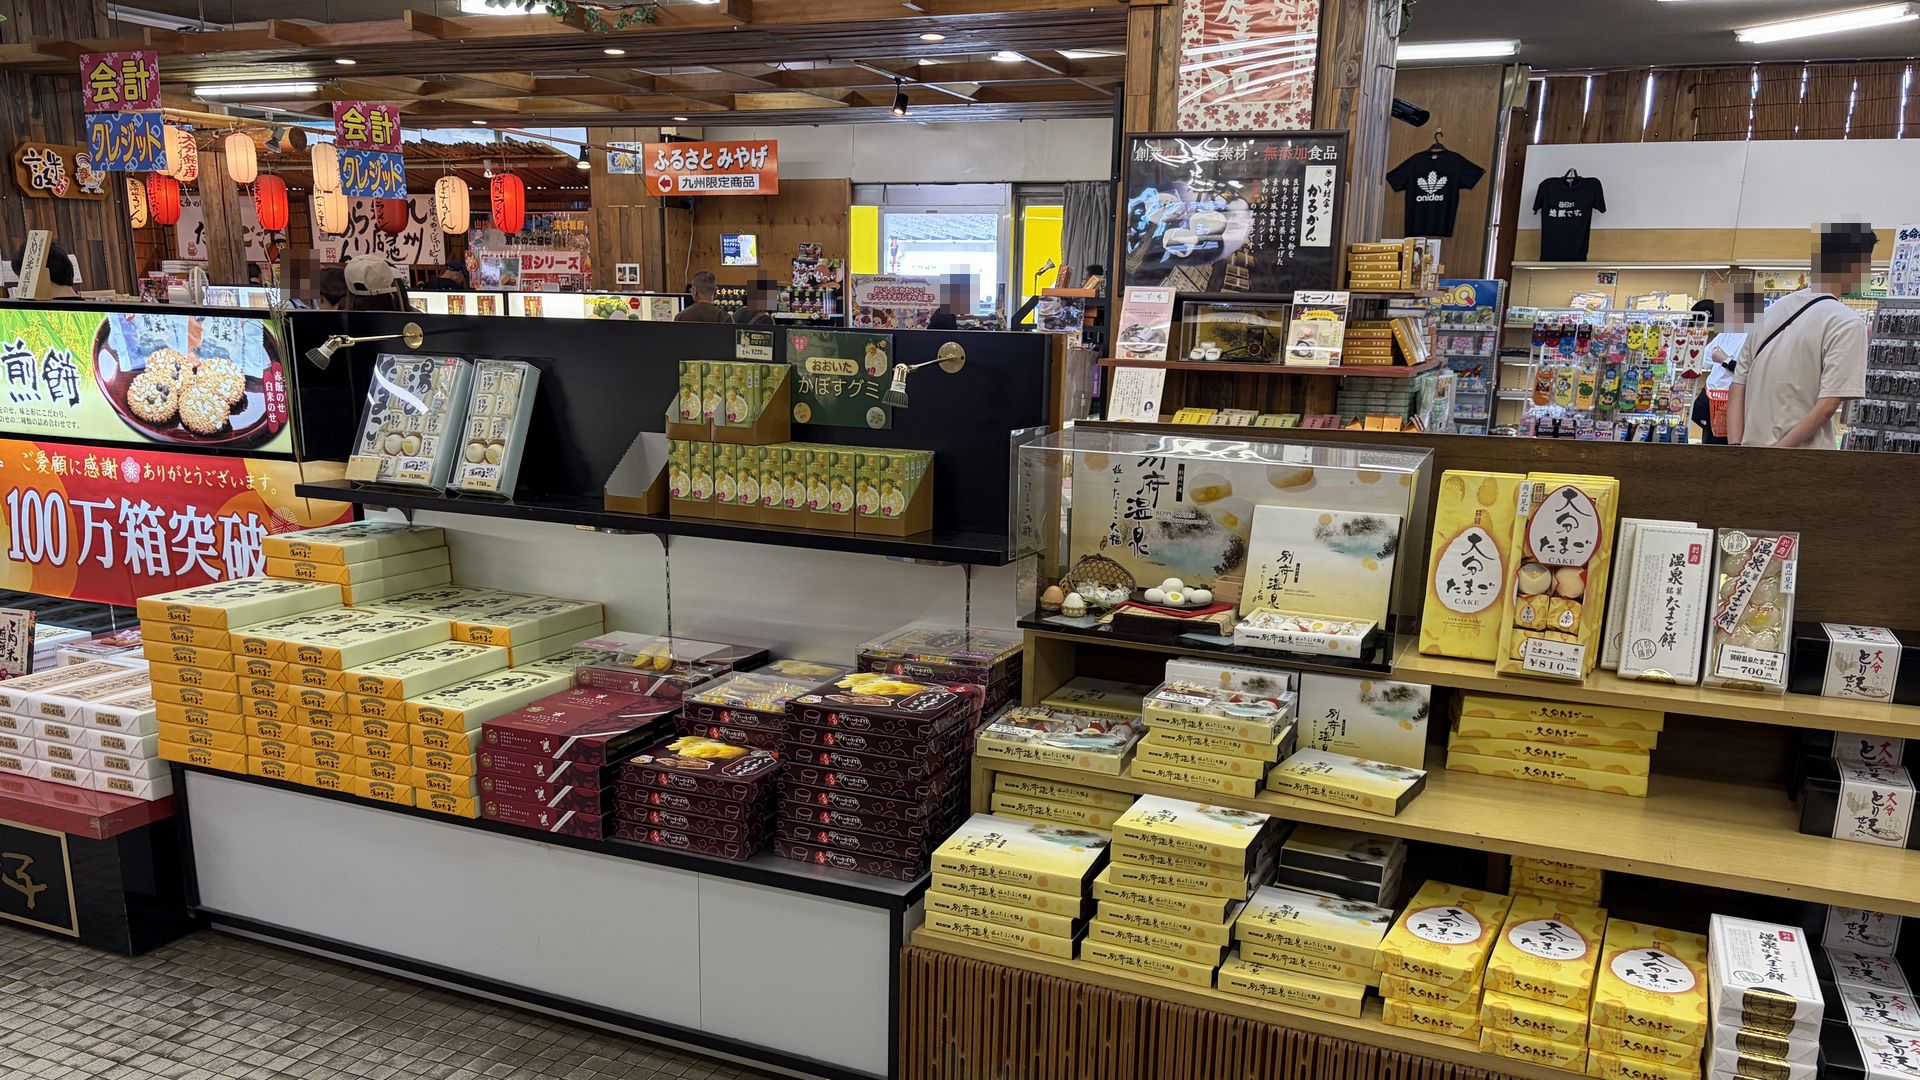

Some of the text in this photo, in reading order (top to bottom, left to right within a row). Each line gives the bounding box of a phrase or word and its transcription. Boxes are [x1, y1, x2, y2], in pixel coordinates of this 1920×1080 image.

[90, 60, 150, 103] 会計
[90, 117, 162, 164] クレジット
[341, 106, 393, 145] 会計
[343, 155, 403, 193] クレジット
[654, 144, 769, 171] ふるさと みやげ
[682, 175, 756, 190] 九州限定商品
[1416, 193, 1444, 202] onides
[1305, 184, 1322, 242] かるかん
[1, 339, 80, 408] 煎餅
[811, 360, 852, 374] おおいた
[265, 381, 277, 423] 白米のせ
[797, 376, 881, 400] かぼすグミ
[22, 451, 279, 496] ご愛顧に感謝 ありがとうございます。
[1554, 487, 1592, 534] 大分
[7, 488, 271, 580] 100万箱突破
[1539, 536, 1592, 554] たまご
[1461, 533, 1495, 577] 大分
[1548, 557, 1575, 565] CAKE
[1667, 553, 1686, 586] 温泉
[1750, 541, 1773, 573] 温泉
[1267, 550, 1295, 610] 別府温泉
[1446, 578, 1496, 596] たまご
[1454, 598, 1480, 606] CAKE
[1719, 581, 1752, 629] たまご餅
[1658, 596, 1681, 651] たまご餅
[1530, 658, 1564, 671] ¥810
[1741, 666, 1764, 676] 700
[1854, 650, 1871, 692] とり天
[1871, 650, 1884, 673] 大分
[1867, 791, 1885, 834] とり天
[1882, 792, 1898, 816] 大分
